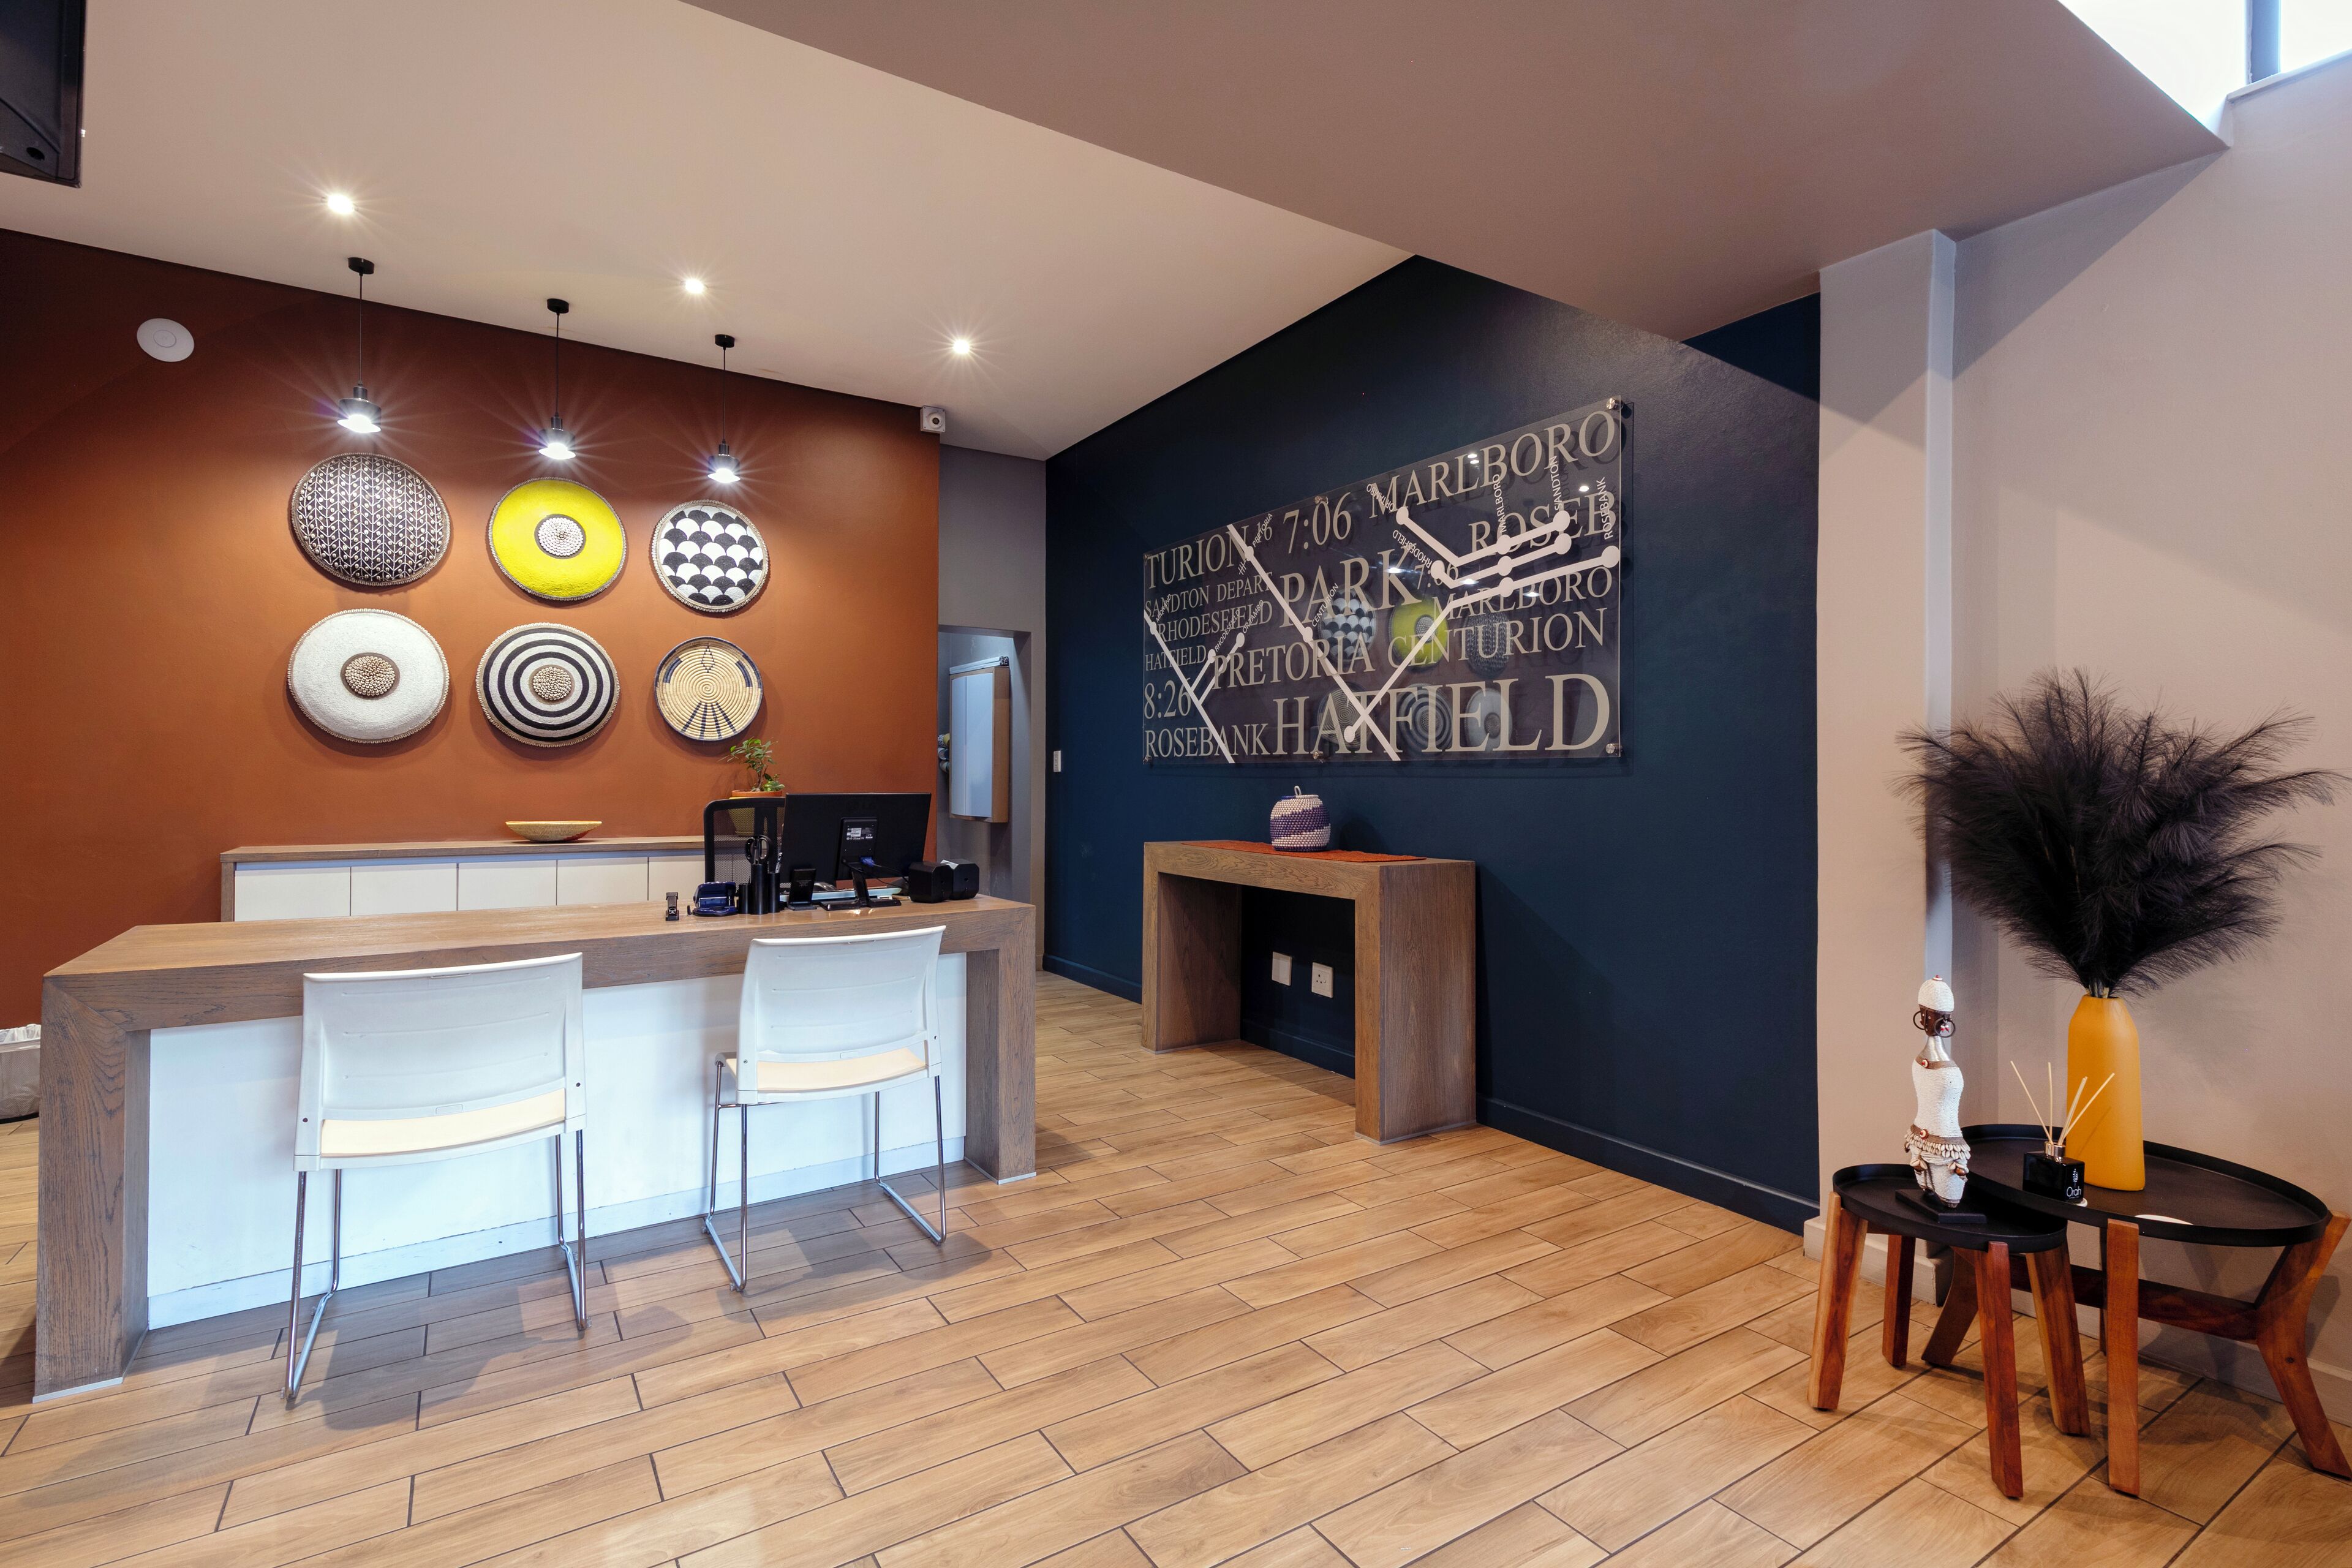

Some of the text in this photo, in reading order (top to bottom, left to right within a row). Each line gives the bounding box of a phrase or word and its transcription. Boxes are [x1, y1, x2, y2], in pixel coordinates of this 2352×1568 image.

[1369, 410, 1615, 518] MARLBORO
[1550, 455, 1563, 511] SANDTON
[1251, 513, 1273, 548] PRETORIA
[1283, 492, 1352, 554] 7:06
[1468, 491, 1617, 556] ROSEB
[1492, 473, 1507, 533] MARLBORO
[1596, 477, 1614, 540] ROSEBANK
[1147, 525, 1250, 589] TURION
[1392, 529, 1433, 569] RHODESFIELD
[1414, 562, 1459, 590] 7:6
[1145, 585, 1210, 619] SANDTON
[1279, 543, 1422, 628] PARK
[1311, 582, 1340, 628] CENTURION
[1431, 565, 1613, 622] MARLBORO
[1157, 600, 1273, 643] RHODESFIELD
[1212, 607, 1608, 690] PRETORIA CENTURION
[1214, 608, 1241, 652] RHODESFIELD
[1144, 677, 1191, 720] 8:26
[1272, 673, 1610, 755] HATFIELD
[1144, 723, 1271, 758] ROSEBANK
